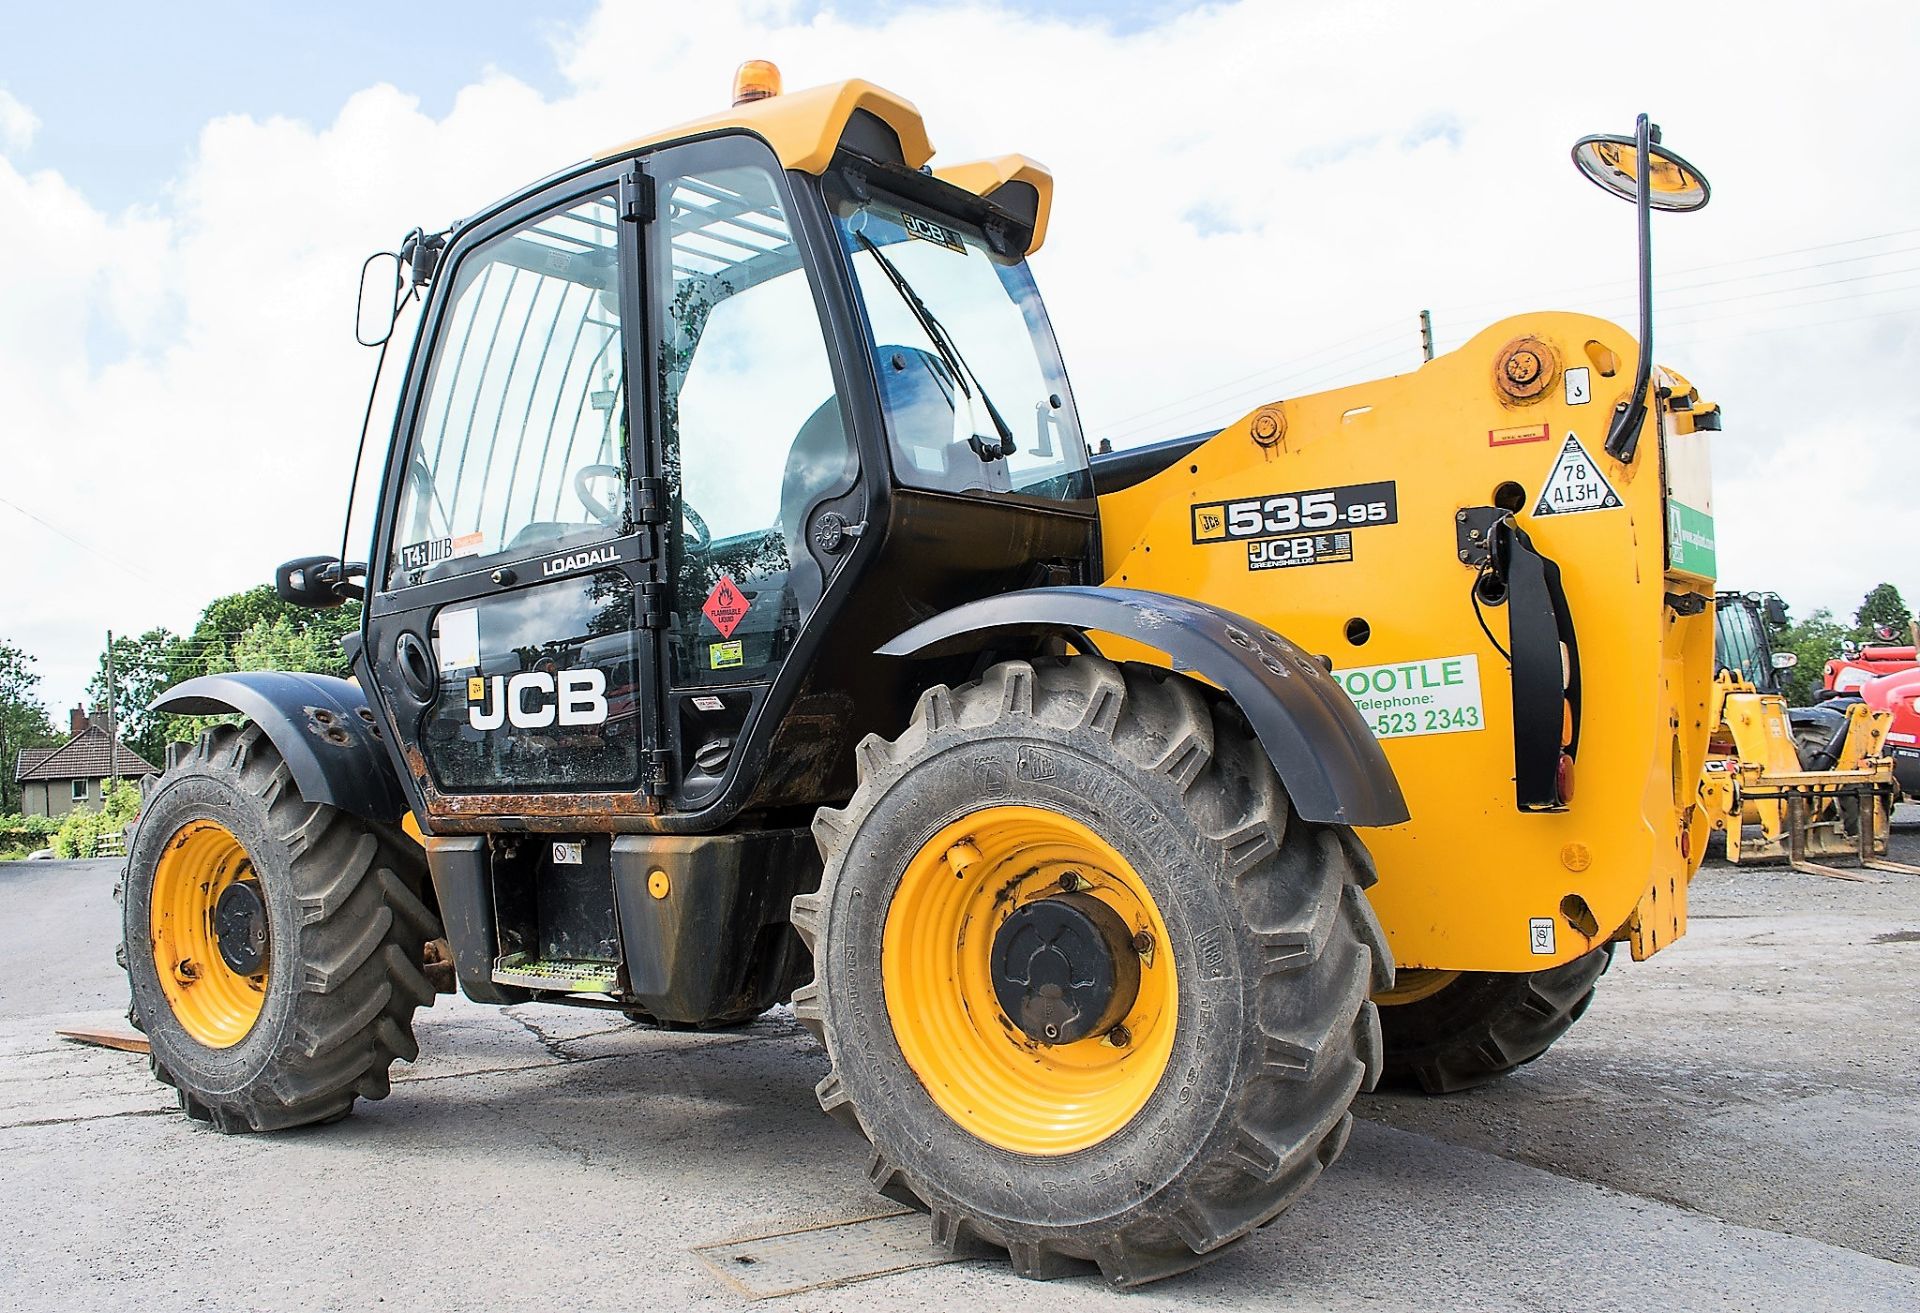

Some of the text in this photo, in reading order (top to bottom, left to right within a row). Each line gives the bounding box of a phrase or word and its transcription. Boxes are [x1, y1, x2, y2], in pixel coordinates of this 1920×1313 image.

[905, 216, 945, 242] JCB
[1564, 464, 1586, 482] 78
[1203, 515, 1220, 530] JCB
[403, 543, 428, 568] T4i
[543, 546, 621, 576] LOADALL
[1249, 537, 1315, 562] JCB
[1250, 557, 1315, 569] GREENSHIELDS
[711, 608, 741, 616] FLAMMABLE
[469, 668, 609, 731] JCB
[1354, 694, 1434, 711] Telephone:
[1425, 706, 1479, 731] 2343
